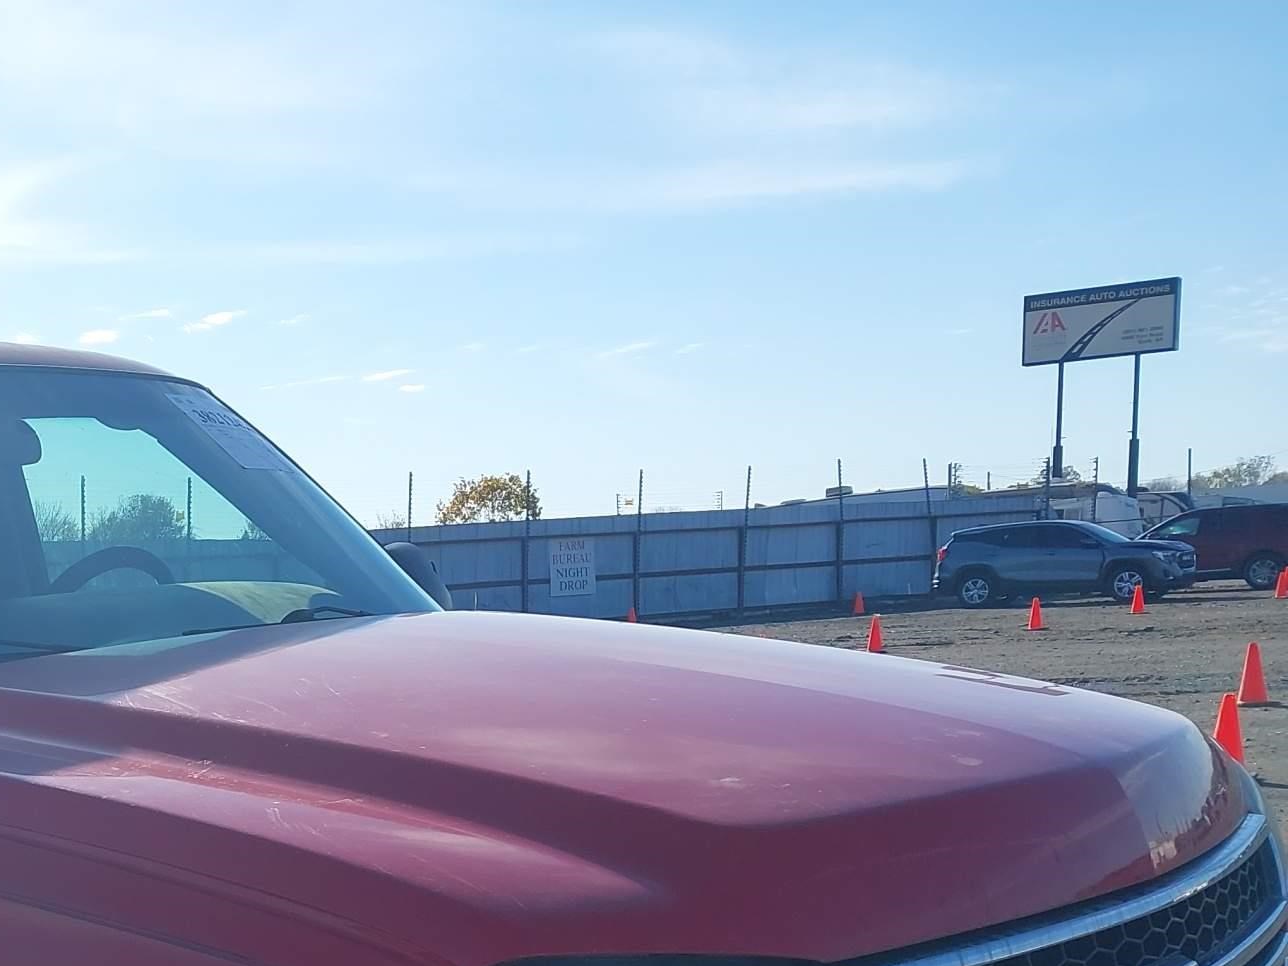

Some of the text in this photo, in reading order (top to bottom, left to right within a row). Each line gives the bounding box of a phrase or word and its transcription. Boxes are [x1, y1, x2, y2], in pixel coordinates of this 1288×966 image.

[1030, 284, 1171, 309] INSURANCE AUTO AUCTIONS
[556, 566, 590, 578] NIGHT
[559, 579, 588, 591] DROP
